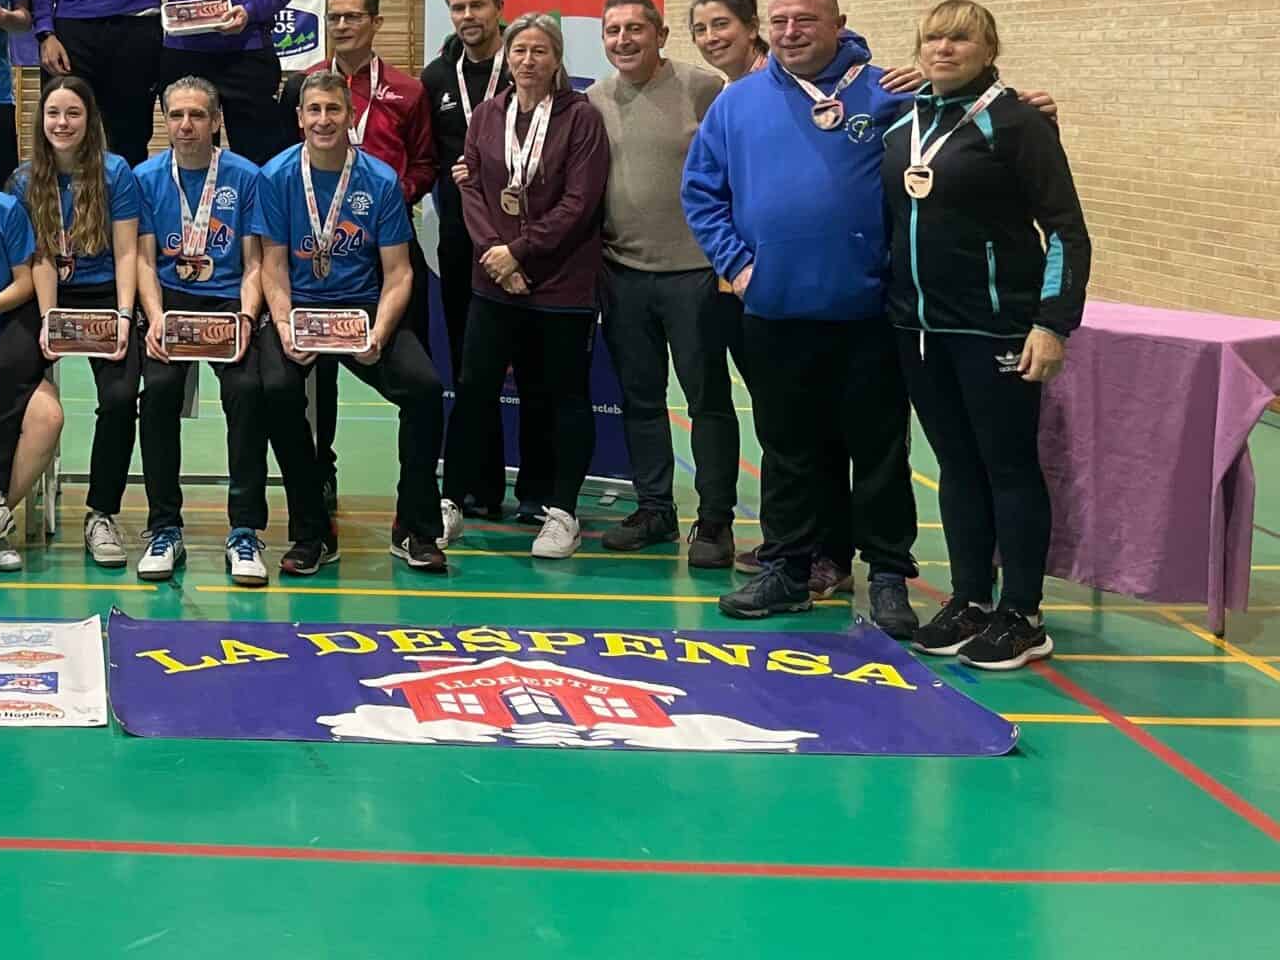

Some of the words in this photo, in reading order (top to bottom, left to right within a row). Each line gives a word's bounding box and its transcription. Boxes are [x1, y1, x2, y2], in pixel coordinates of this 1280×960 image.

[135, 639, 289, 674] LA
[297, 628, 918, 690] DESPENSA
[434, 675, 611, 695] LLORENTE
